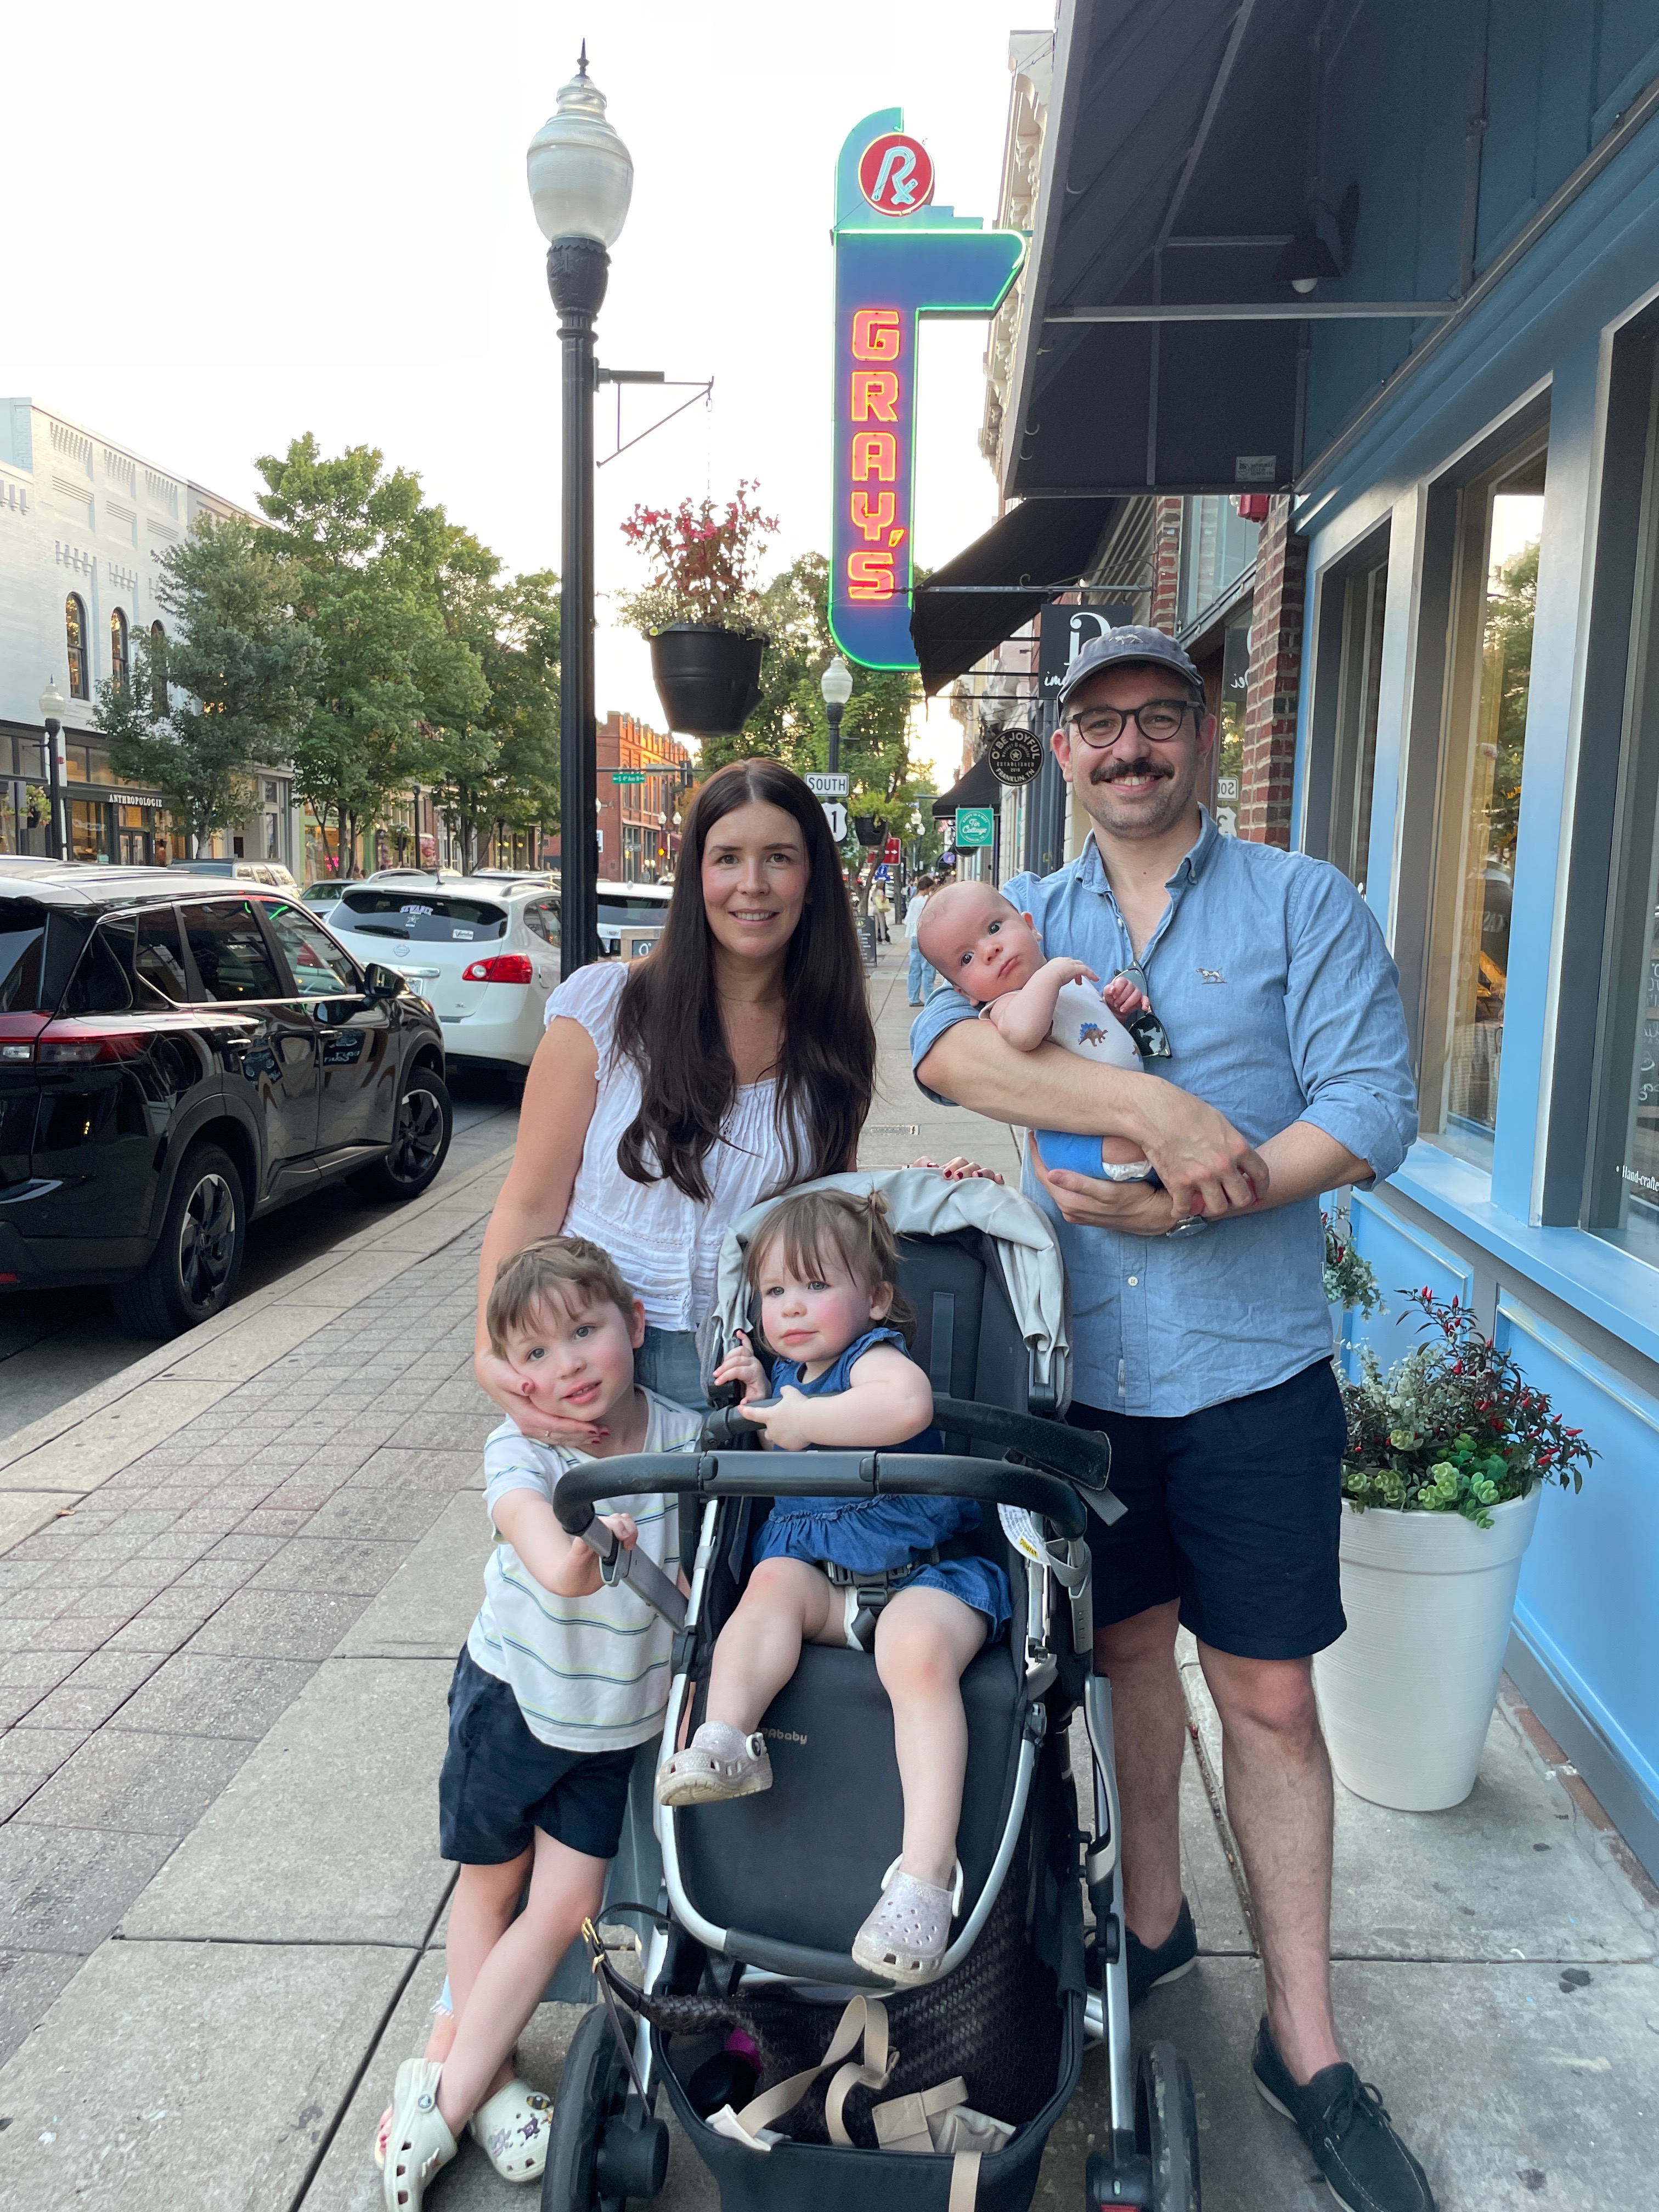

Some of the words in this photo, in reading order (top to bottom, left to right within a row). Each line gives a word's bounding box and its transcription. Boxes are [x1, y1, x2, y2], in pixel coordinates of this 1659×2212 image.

[848, 309, 905, 600] GRAY'S
[995, 736, 1009, 749] BE
[1009, 732, 1040, 759] JOYFUL
[1025, 769, 1035, 777] TN
[809, 777, 845, 791] SOUTH
[109, 794, 162, 808] ANTHROPOLOGIE
